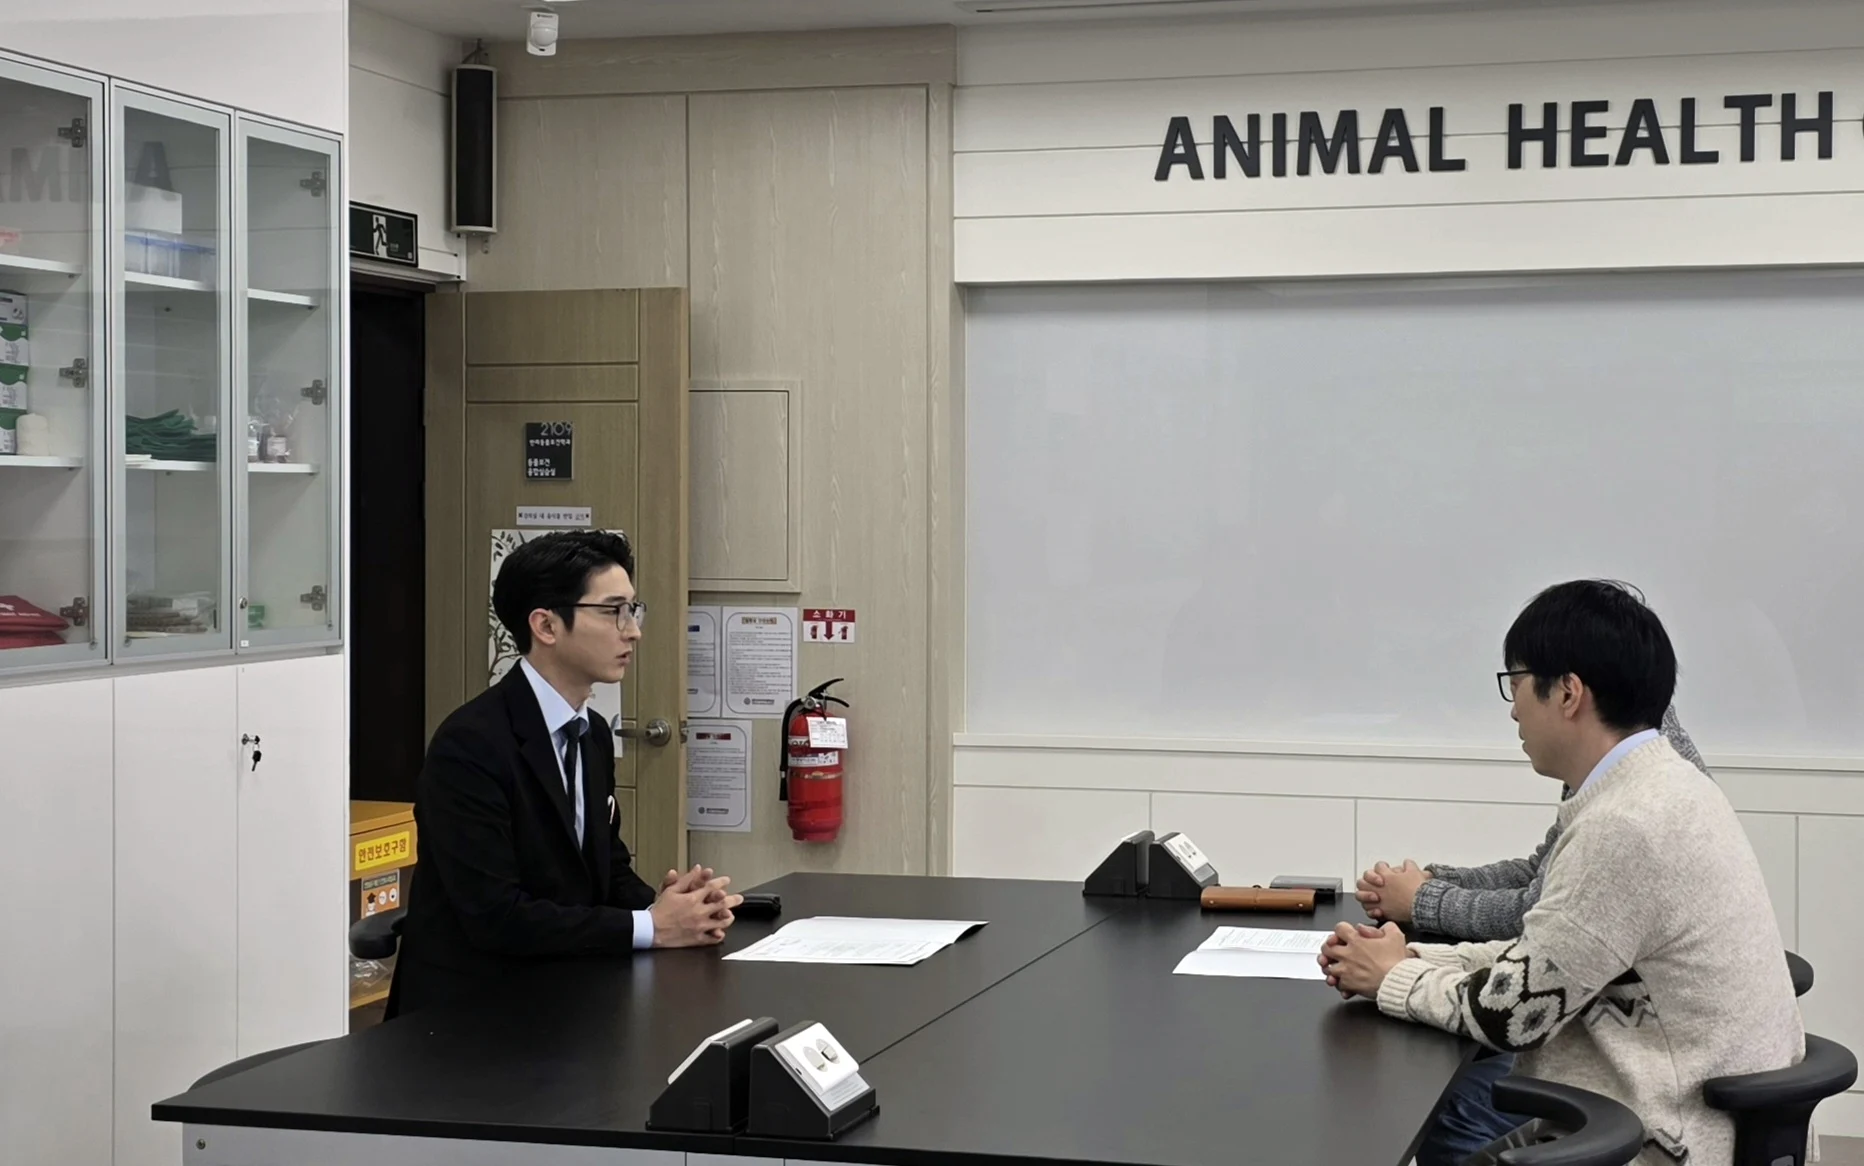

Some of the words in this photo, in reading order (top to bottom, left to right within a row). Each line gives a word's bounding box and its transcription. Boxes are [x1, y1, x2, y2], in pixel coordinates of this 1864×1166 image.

[1154, 106, 1466, 182] ANIMAL
[1506, 91, 1834, 170] HEALTH
[528, 458, 550, 466] 동물보건
[812, 610, 846, 619] 소화기
[358, 838, 406, 863] 안전보호구함
